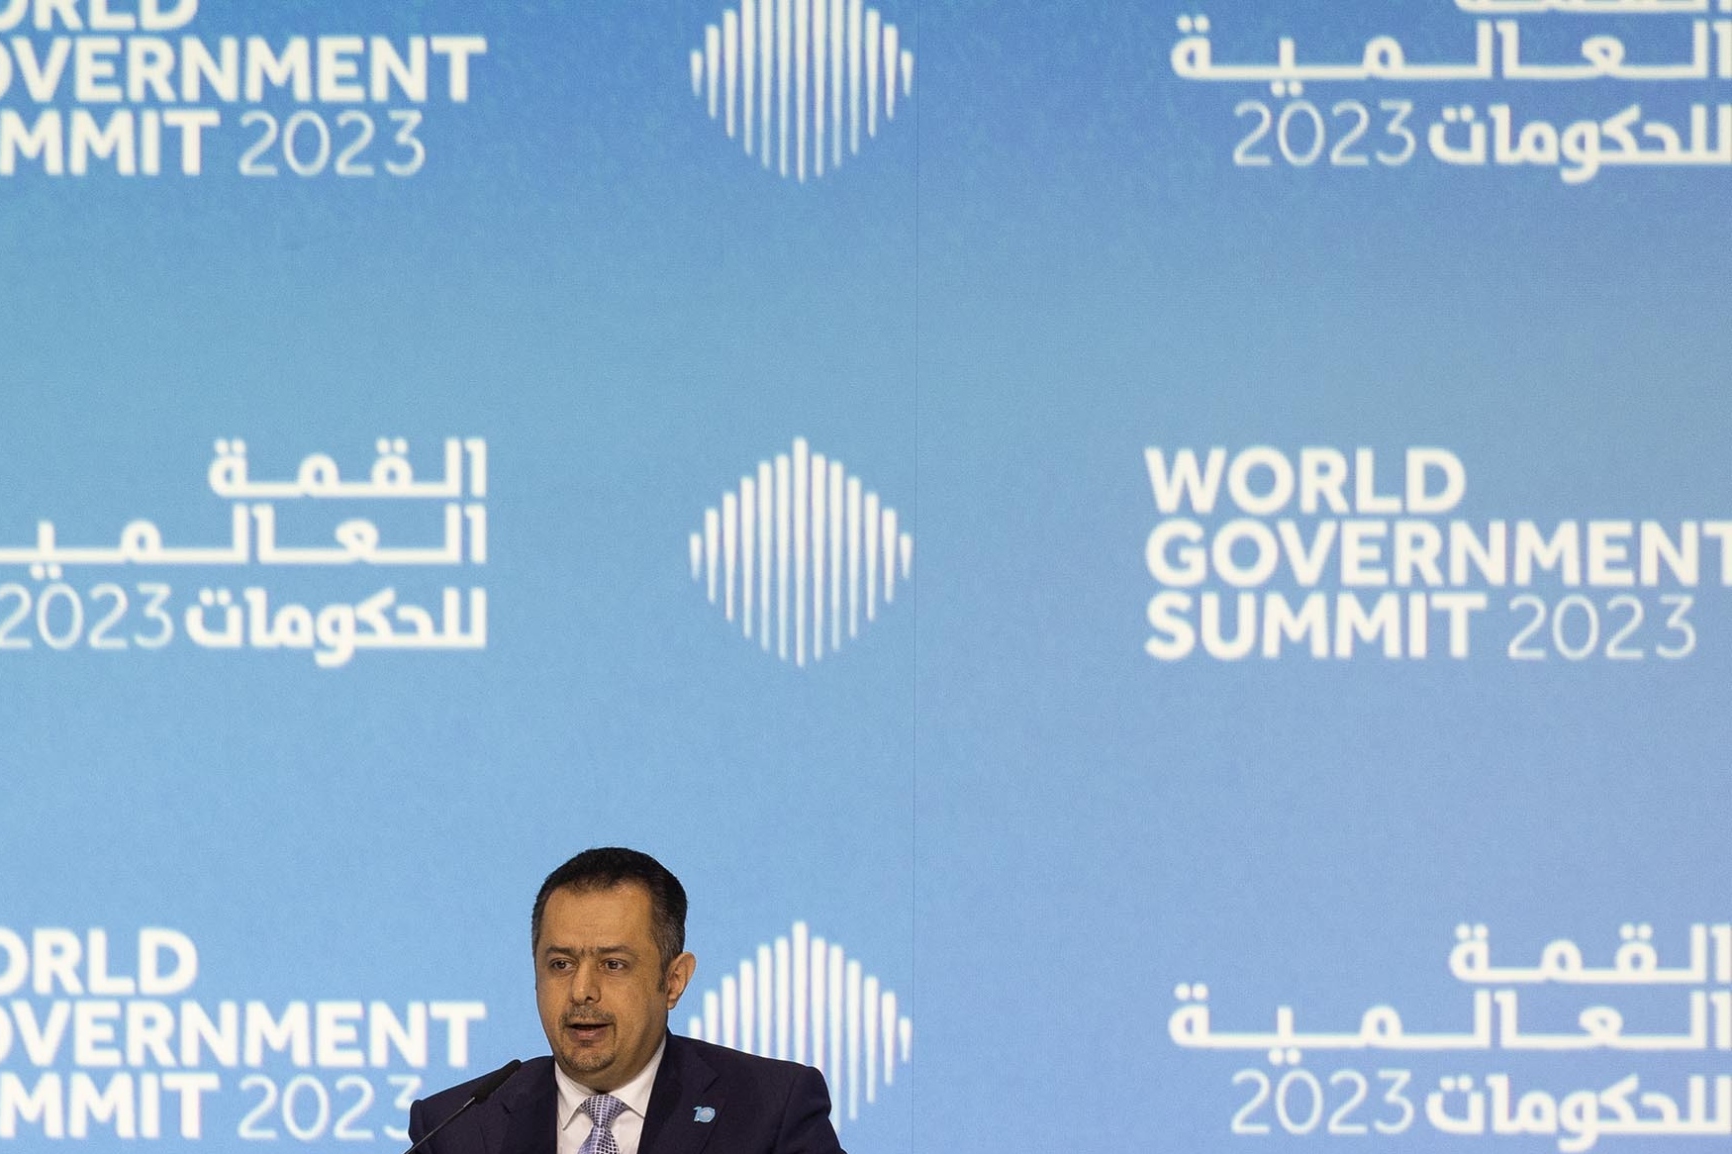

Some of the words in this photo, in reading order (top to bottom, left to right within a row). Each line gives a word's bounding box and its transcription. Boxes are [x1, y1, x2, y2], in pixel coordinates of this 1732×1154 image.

[1171, 16, 1732, 96] العالمية
[239, 110, 425, 176] 2023
[1233, 100, 1416, 166] 2023
[1429, 105, 1732, 184] للحكومات
[209, 438, 486, 498] القمة
[1145, 447, 1465, 515] WORLD
[1146, 519, 1732, 587] GOVERNMENT
[185, 588, 486, 667] للحكومات
[1146, 591, 1487, 660] SUMMIT
[1508, 594, 1696, 660] 2023
[1449, 924, 1732, 984] القمة
[1169, 983, 1732, 1066] العالمية
[1231, 1068, 1415, 1136] 2023
[1426, 1075, 1732, 1153] للحكومات
